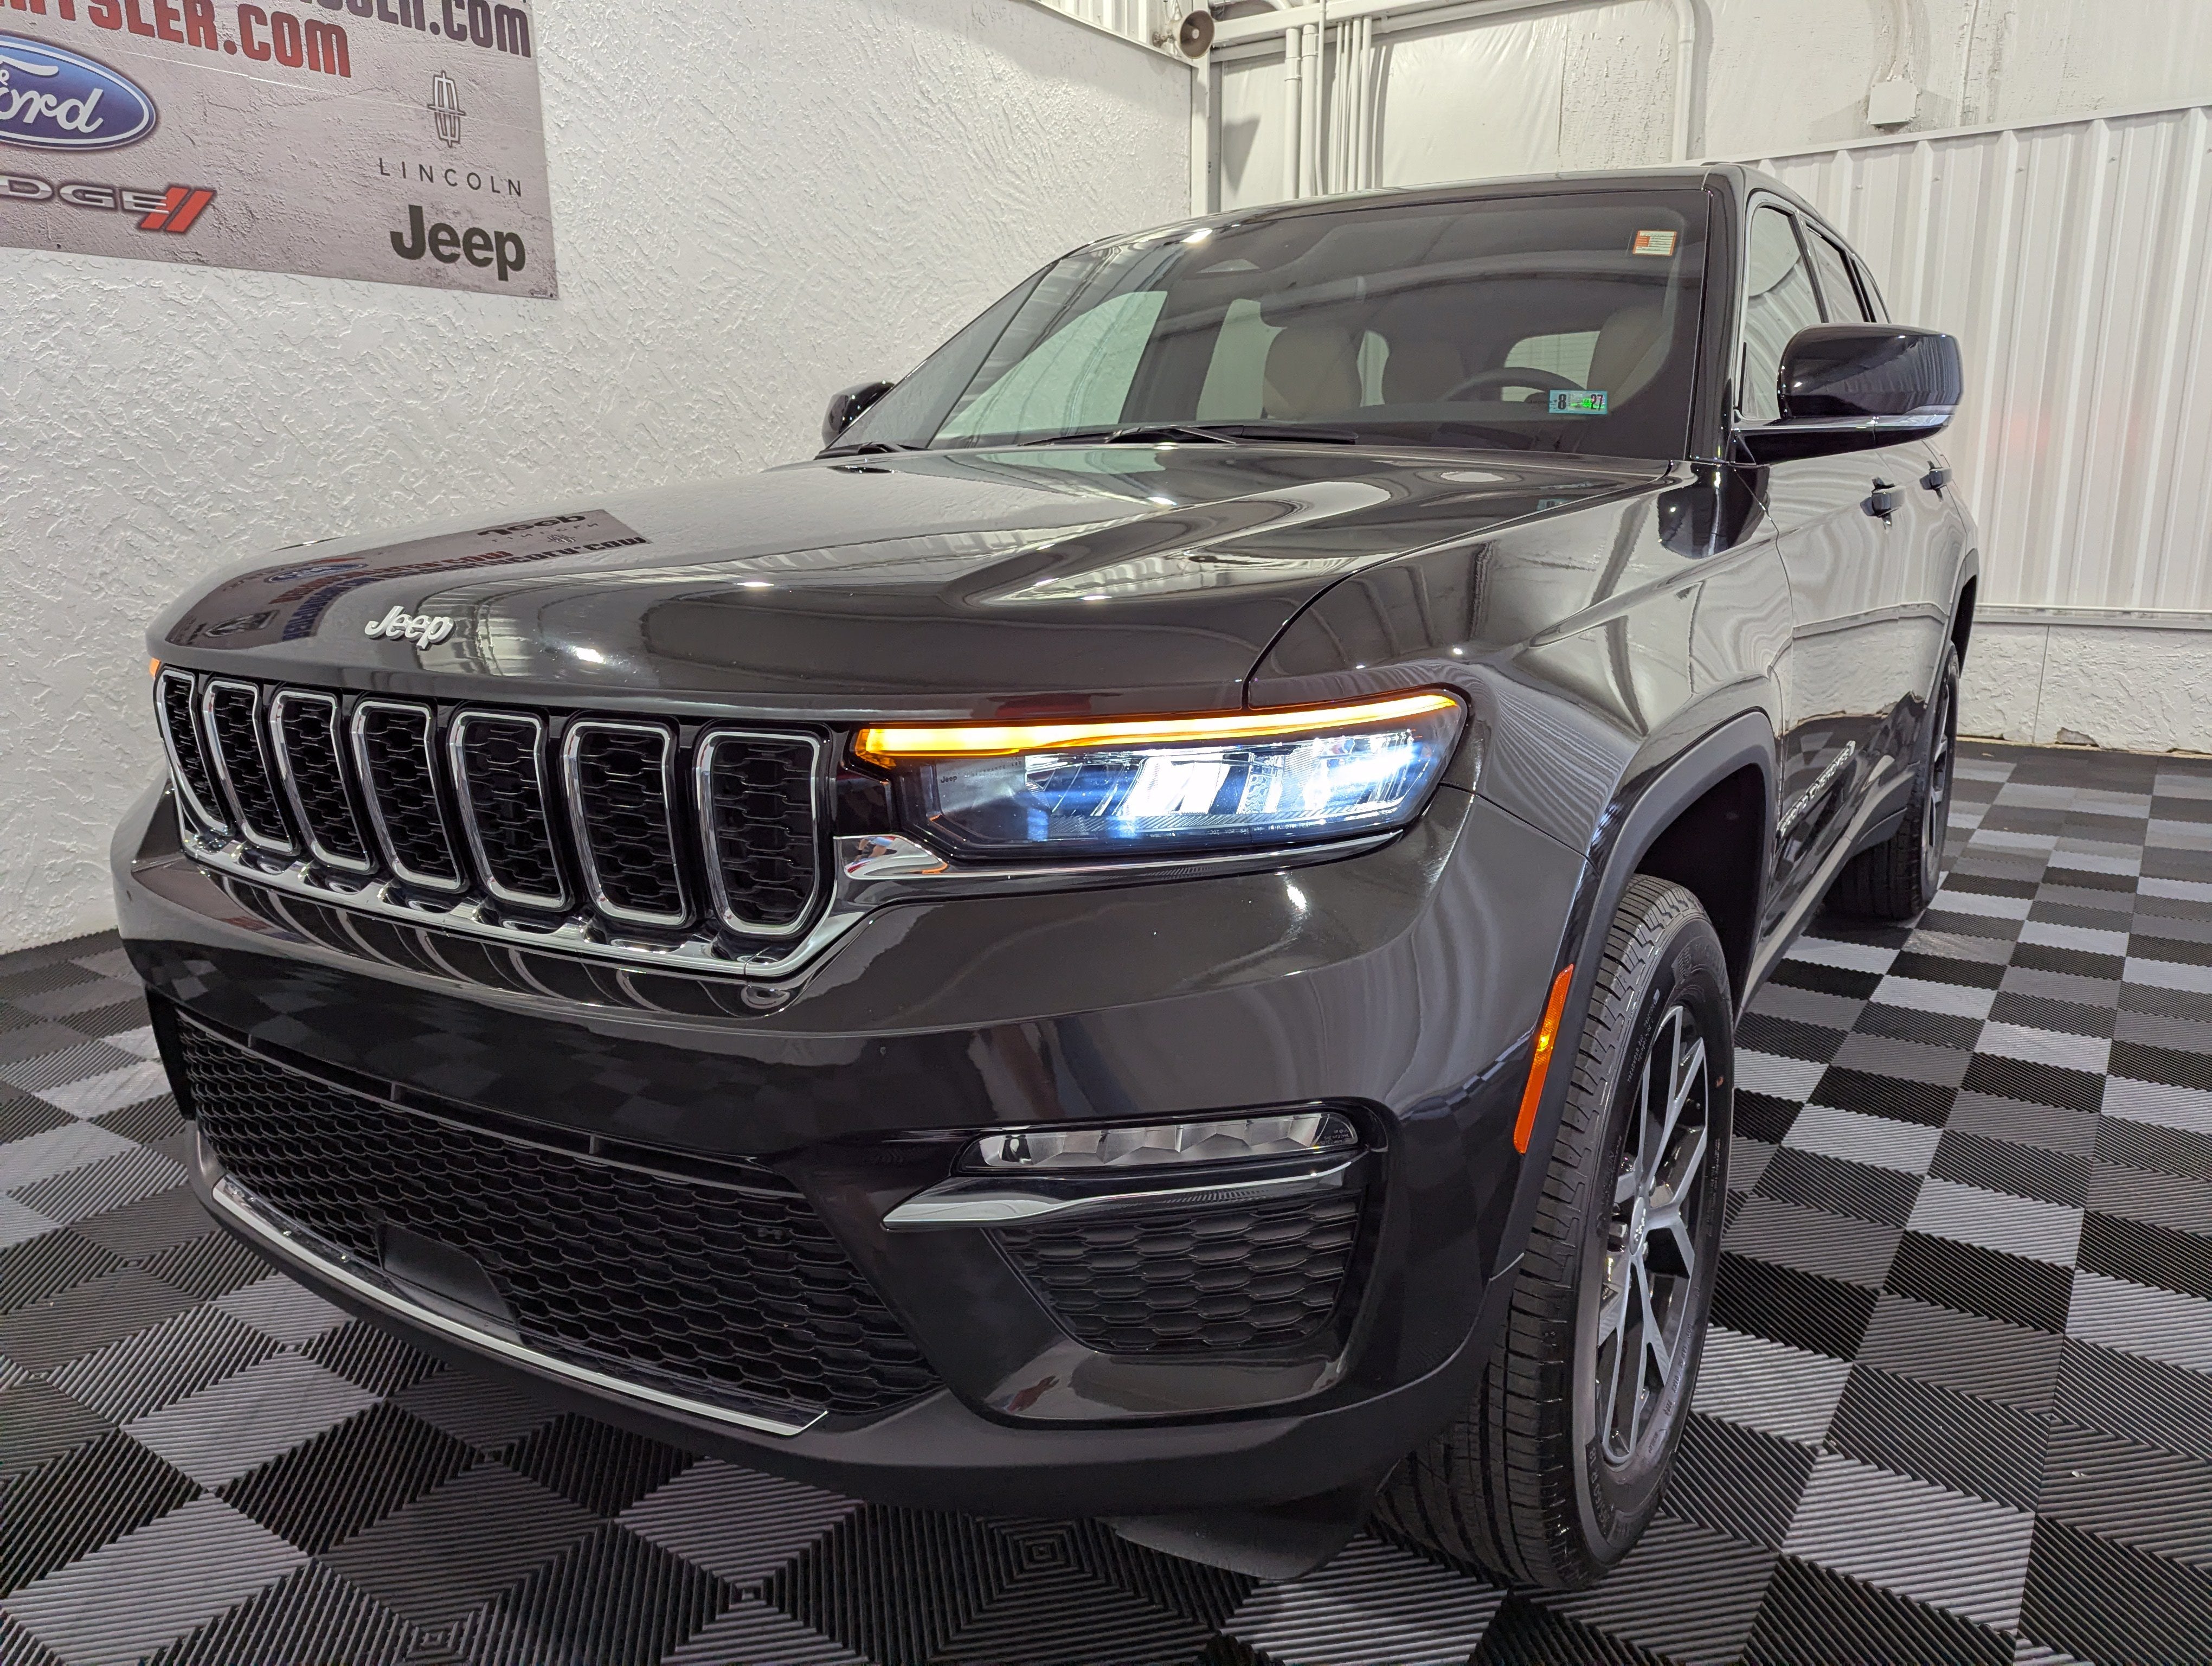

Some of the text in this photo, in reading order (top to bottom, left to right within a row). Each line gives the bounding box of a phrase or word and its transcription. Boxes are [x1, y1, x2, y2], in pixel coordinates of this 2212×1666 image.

[379, 157, 522, 197] LINCOLN
[390, 204, 526, 282] Jeep
[1558, 394, 1603, 411] 8 27
[364, 605, 454, 650] Jeep
[941, 776, 957, 784] Jeep
